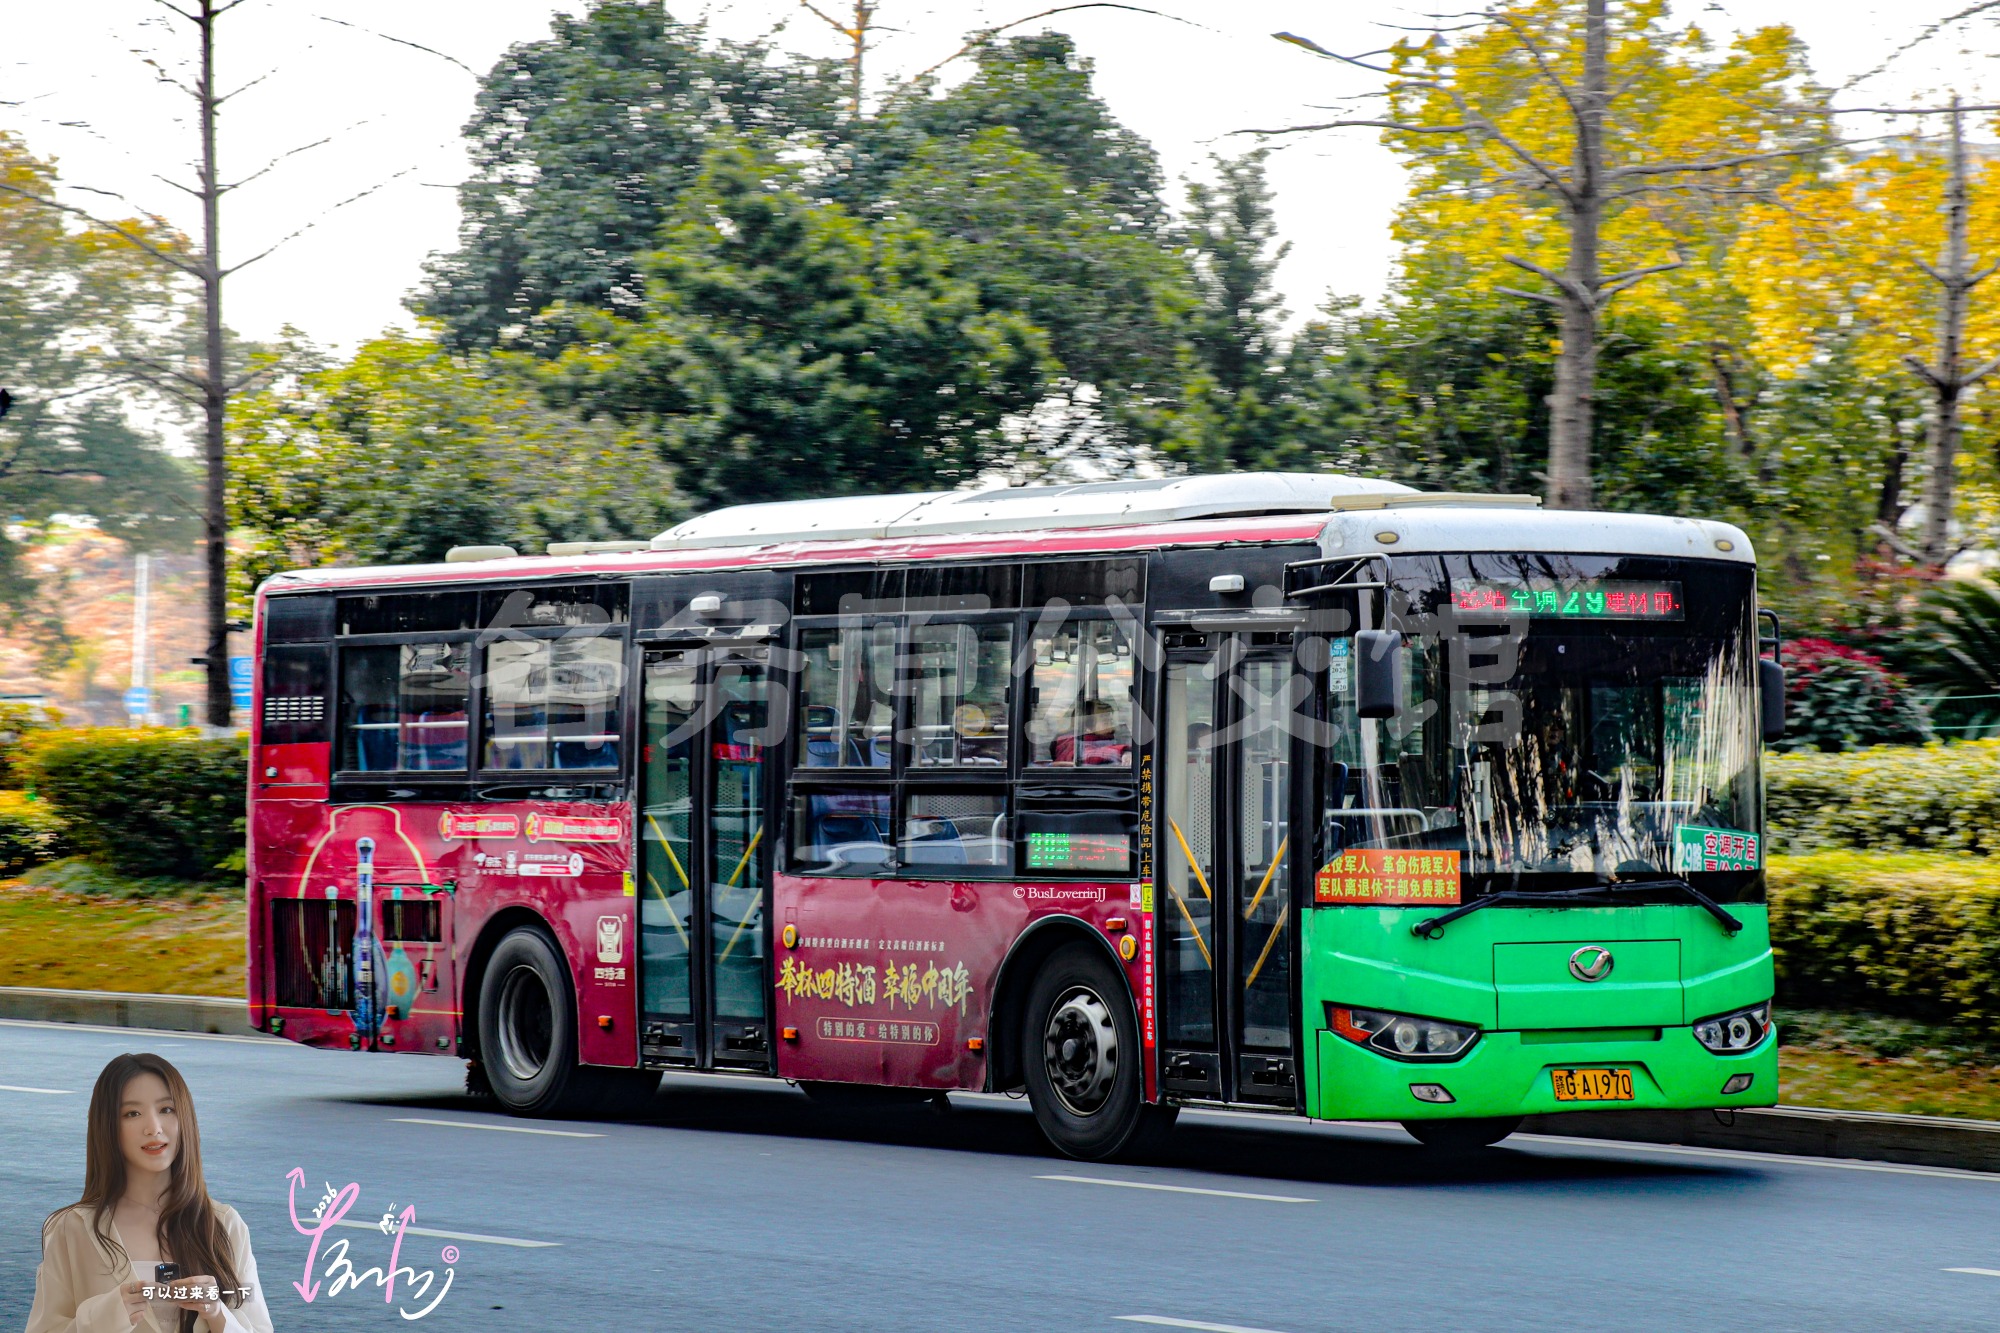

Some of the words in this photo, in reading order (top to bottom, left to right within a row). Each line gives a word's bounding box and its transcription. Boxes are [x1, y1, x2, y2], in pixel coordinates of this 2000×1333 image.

[1140, 754, 1152, 879] 严禁携带危险品上车
[1704, 832, 1757, 862] 空调开启
[1319, 877, 1457, 898] 军队离退休干部免费乘车
[775, 956, 876, 1007] 举杯四特酒
[882, 959, 974, 1018] 幸福中国年
[823, 1020, 866, 1039] 特别的爱
[878, 1023, 934, 1043] 给特别的你
